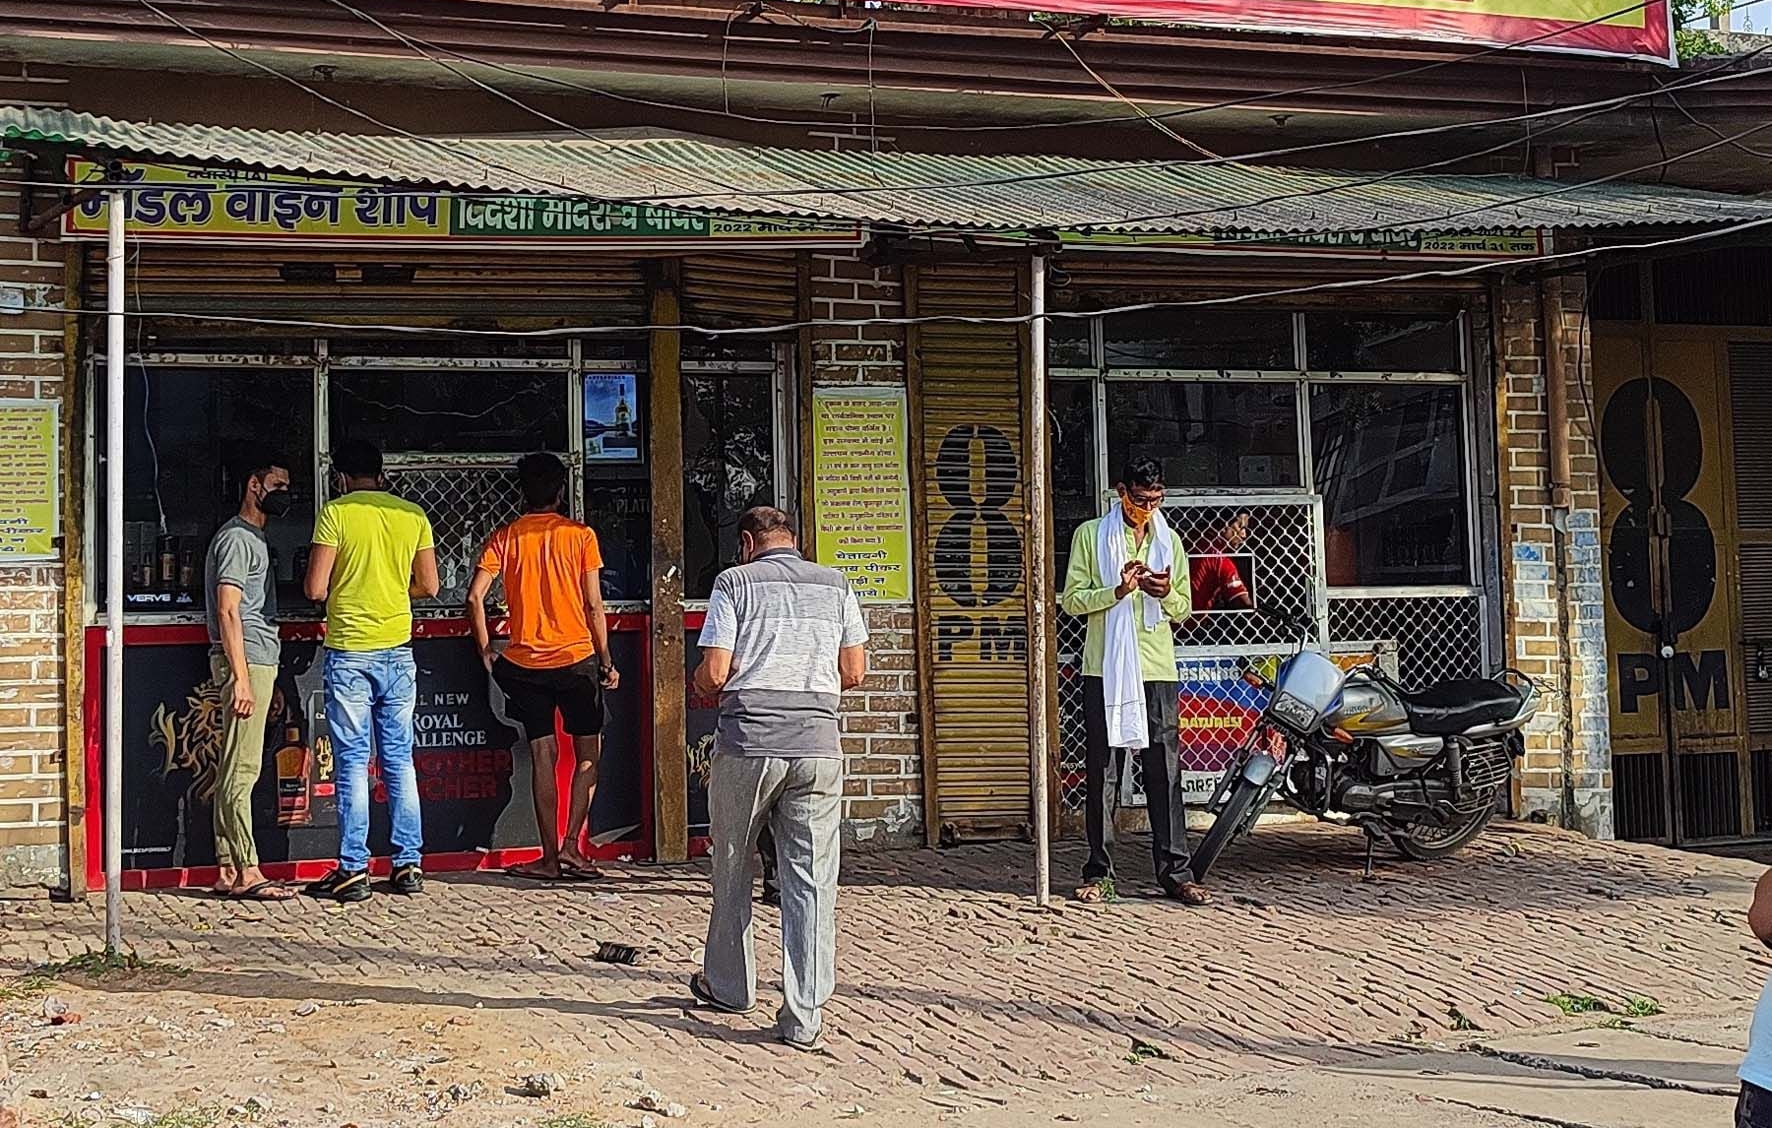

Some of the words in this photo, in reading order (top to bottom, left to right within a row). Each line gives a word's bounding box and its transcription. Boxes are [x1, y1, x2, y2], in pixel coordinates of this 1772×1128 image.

[713, 223, 752, 233] 2022
[1424, 241, 1456, 251] 2022
[127, 593, 171, 603] VERVE
[936, 615, 1027, 663] PM
[1617, 649, 1731, 714] PM
[434, 693, 470, 706] NEW
[412, 713, 464, 730] ROYAL
[412, 730, 487, 748] ALLENGE
